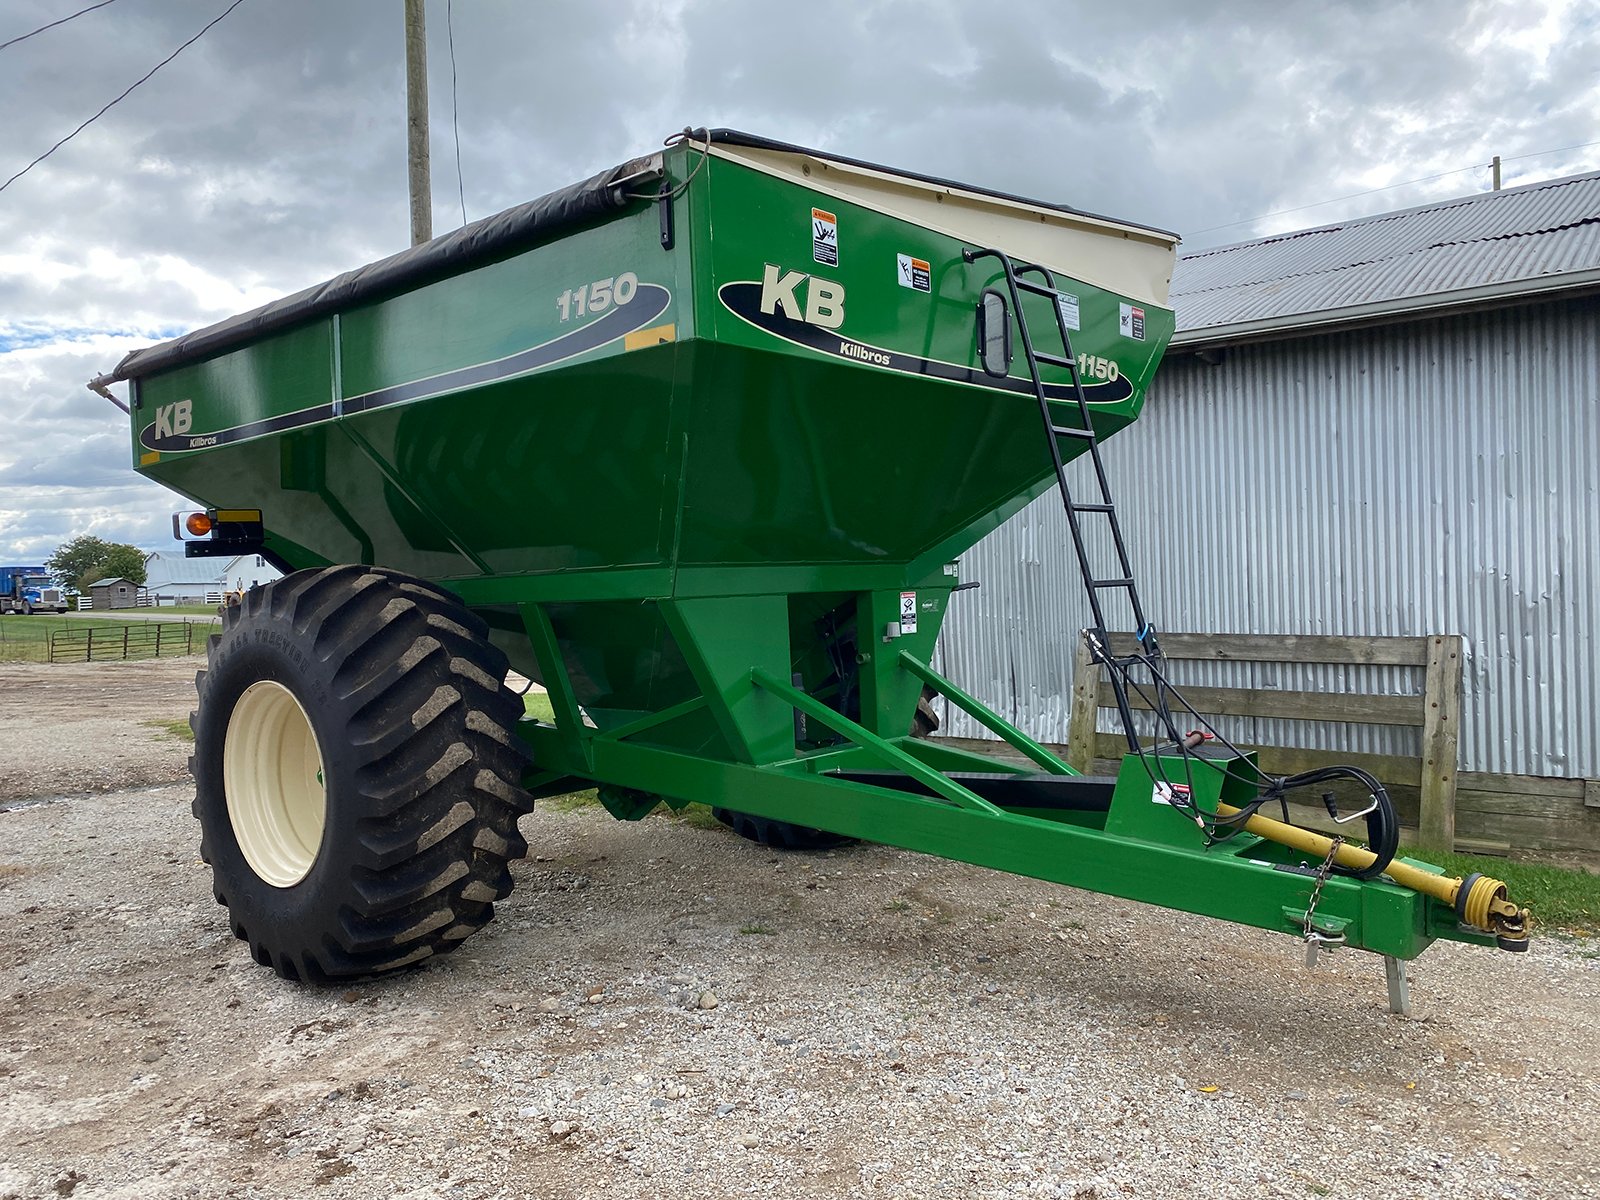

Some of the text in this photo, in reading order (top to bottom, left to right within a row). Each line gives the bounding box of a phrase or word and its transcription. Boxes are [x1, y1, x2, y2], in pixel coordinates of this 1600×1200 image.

[556, 271, 639, 322] 1150
[760, 262, 846, 330] KB
[839, 341, 891, 365] Killbros
[1077, 352, 1119, 382] 1150
[154, 399, 193, 441] KB
[189, 436, 217, 448] Killbros
